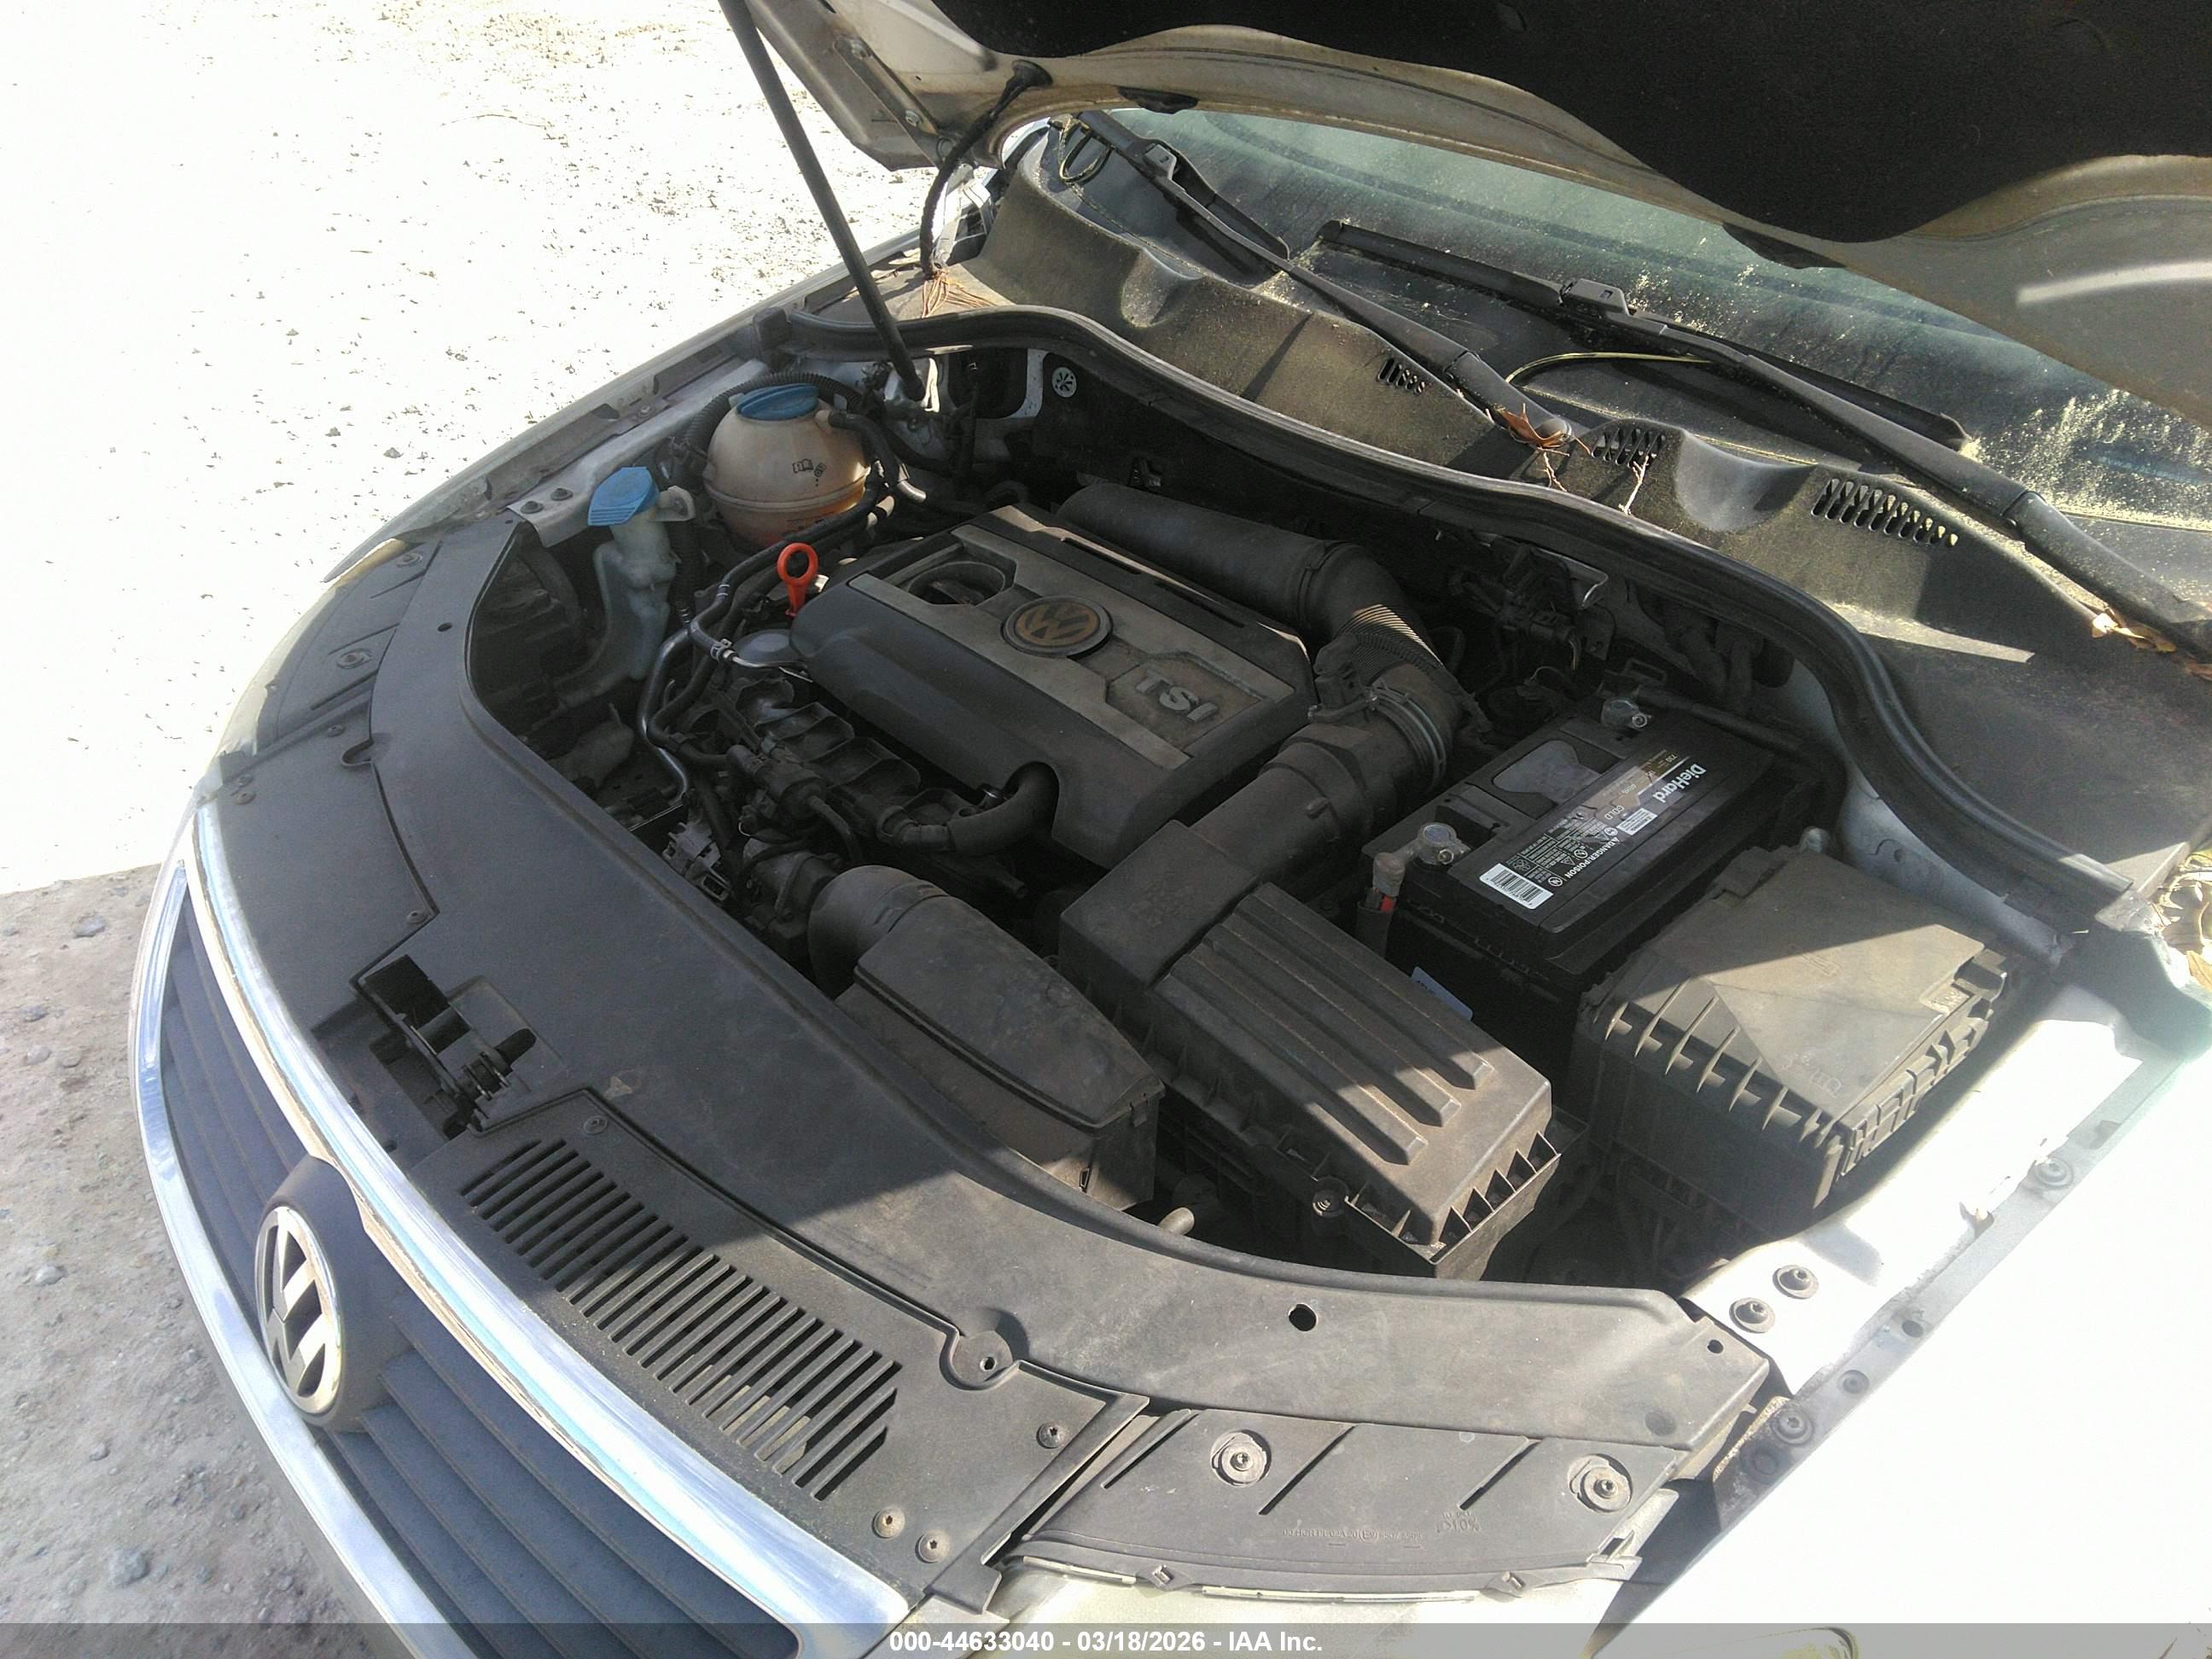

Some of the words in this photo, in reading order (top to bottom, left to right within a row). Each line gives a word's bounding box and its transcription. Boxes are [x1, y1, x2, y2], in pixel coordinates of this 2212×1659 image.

[1136, 669, 1218, 723] TSI
[1651, 763, 1708, 804] DieHard
[1603, 805, 1625, 821] GOLD
[1563, 838, 1616, 879] DANGER/POISON
